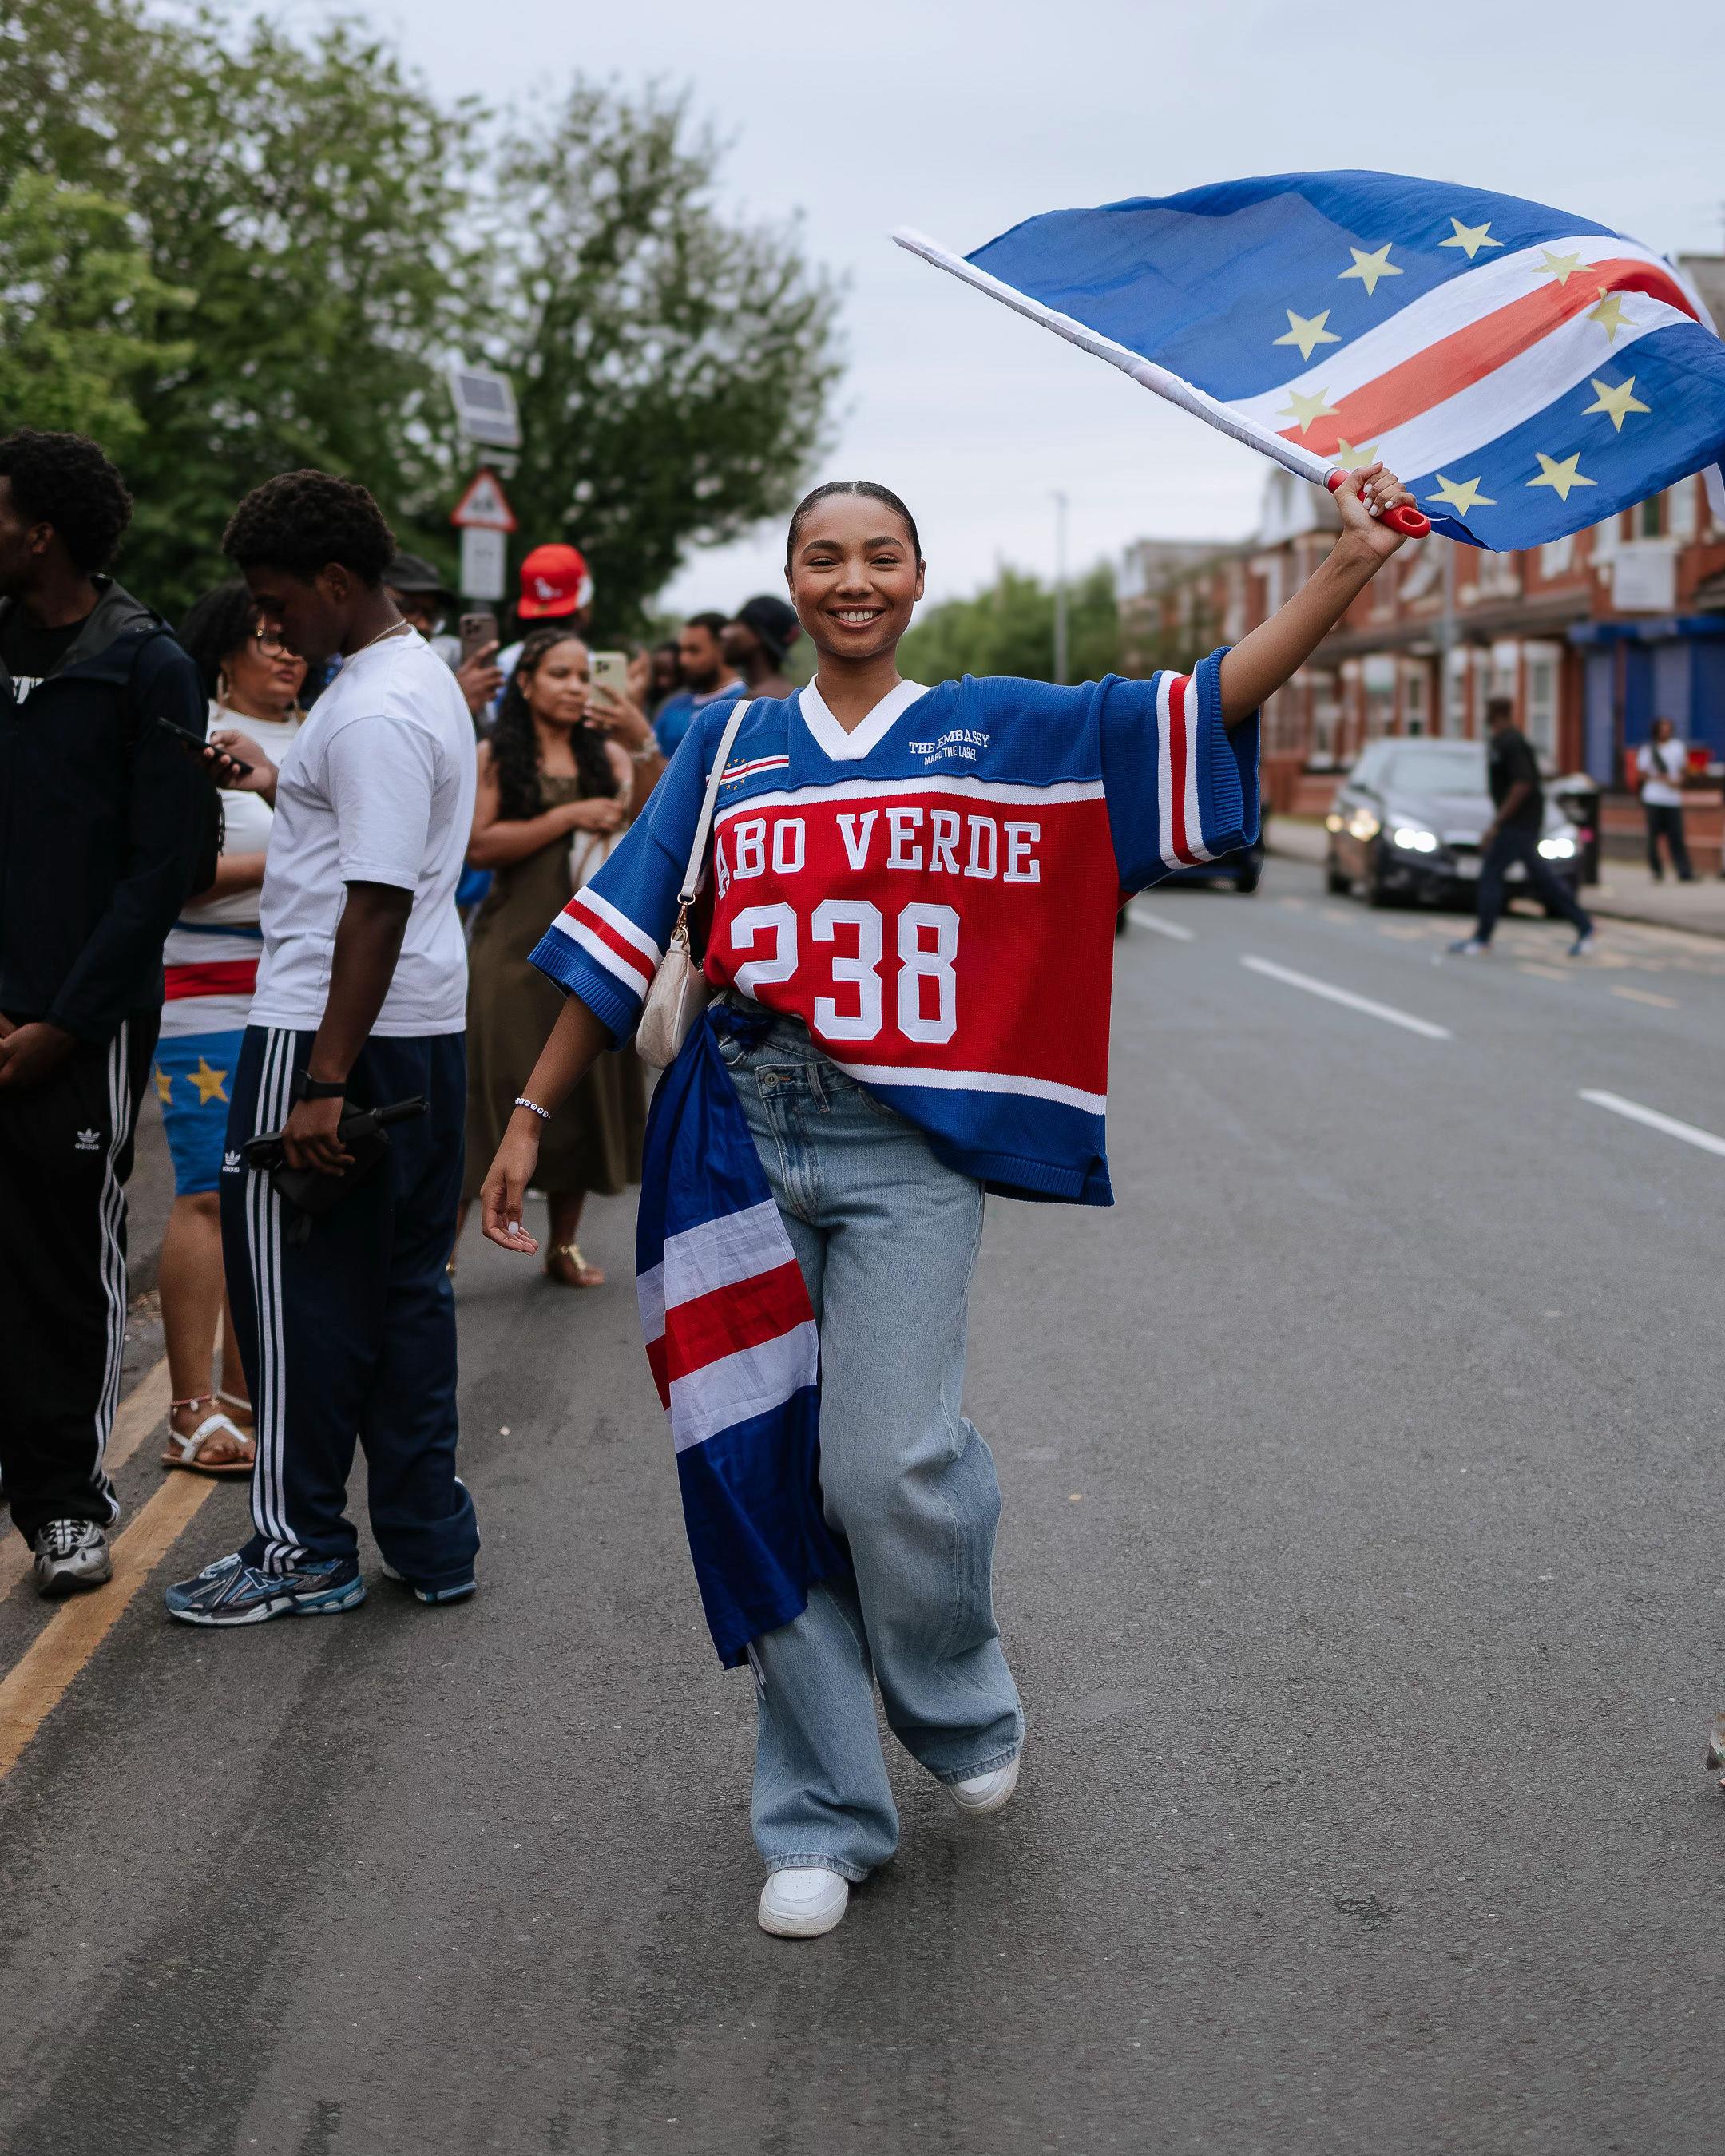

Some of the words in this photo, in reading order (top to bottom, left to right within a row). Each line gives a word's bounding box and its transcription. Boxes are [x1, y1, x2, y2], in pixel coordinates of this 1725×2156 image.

[909, 741, 936, 754] THE
[936, 729, 990, 749] EMBASSY
[942, 745, 958, 758] THE
[958, 745, 977, 761] LABEL
[716, 817, 806, 901] ABO
[836, 807, 1041, 883] VERDE
[730, 899, 960, 1044] 238
